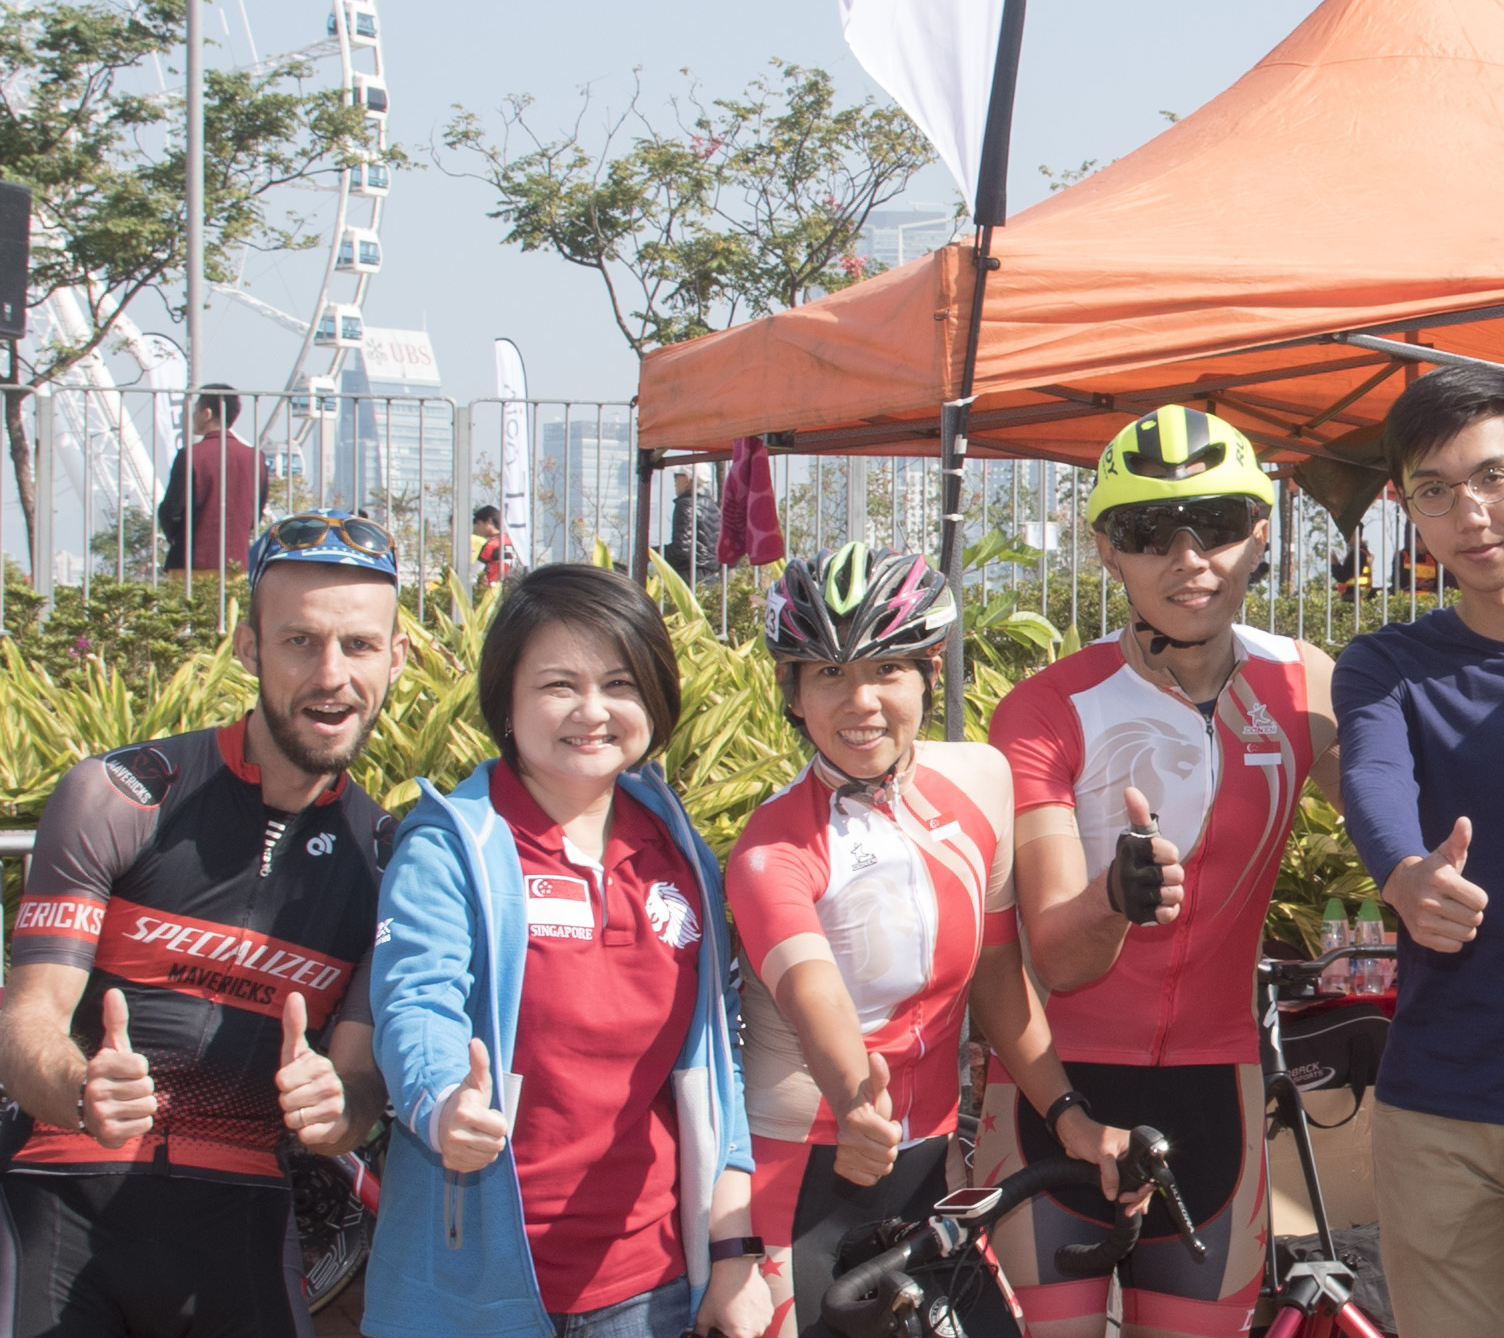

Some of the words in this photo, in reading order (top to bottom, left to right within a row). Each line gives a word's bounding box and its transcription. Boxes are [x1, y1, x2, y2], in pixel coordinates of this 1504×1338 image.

[122, 916, 342, 991] SPECIALIZED
[530, 924, 593, 941] SINGAPORE
[167, 963, 277, 1006] MAVERICKS
[1171, 1183, 1196, 1235] ULTEGRA
